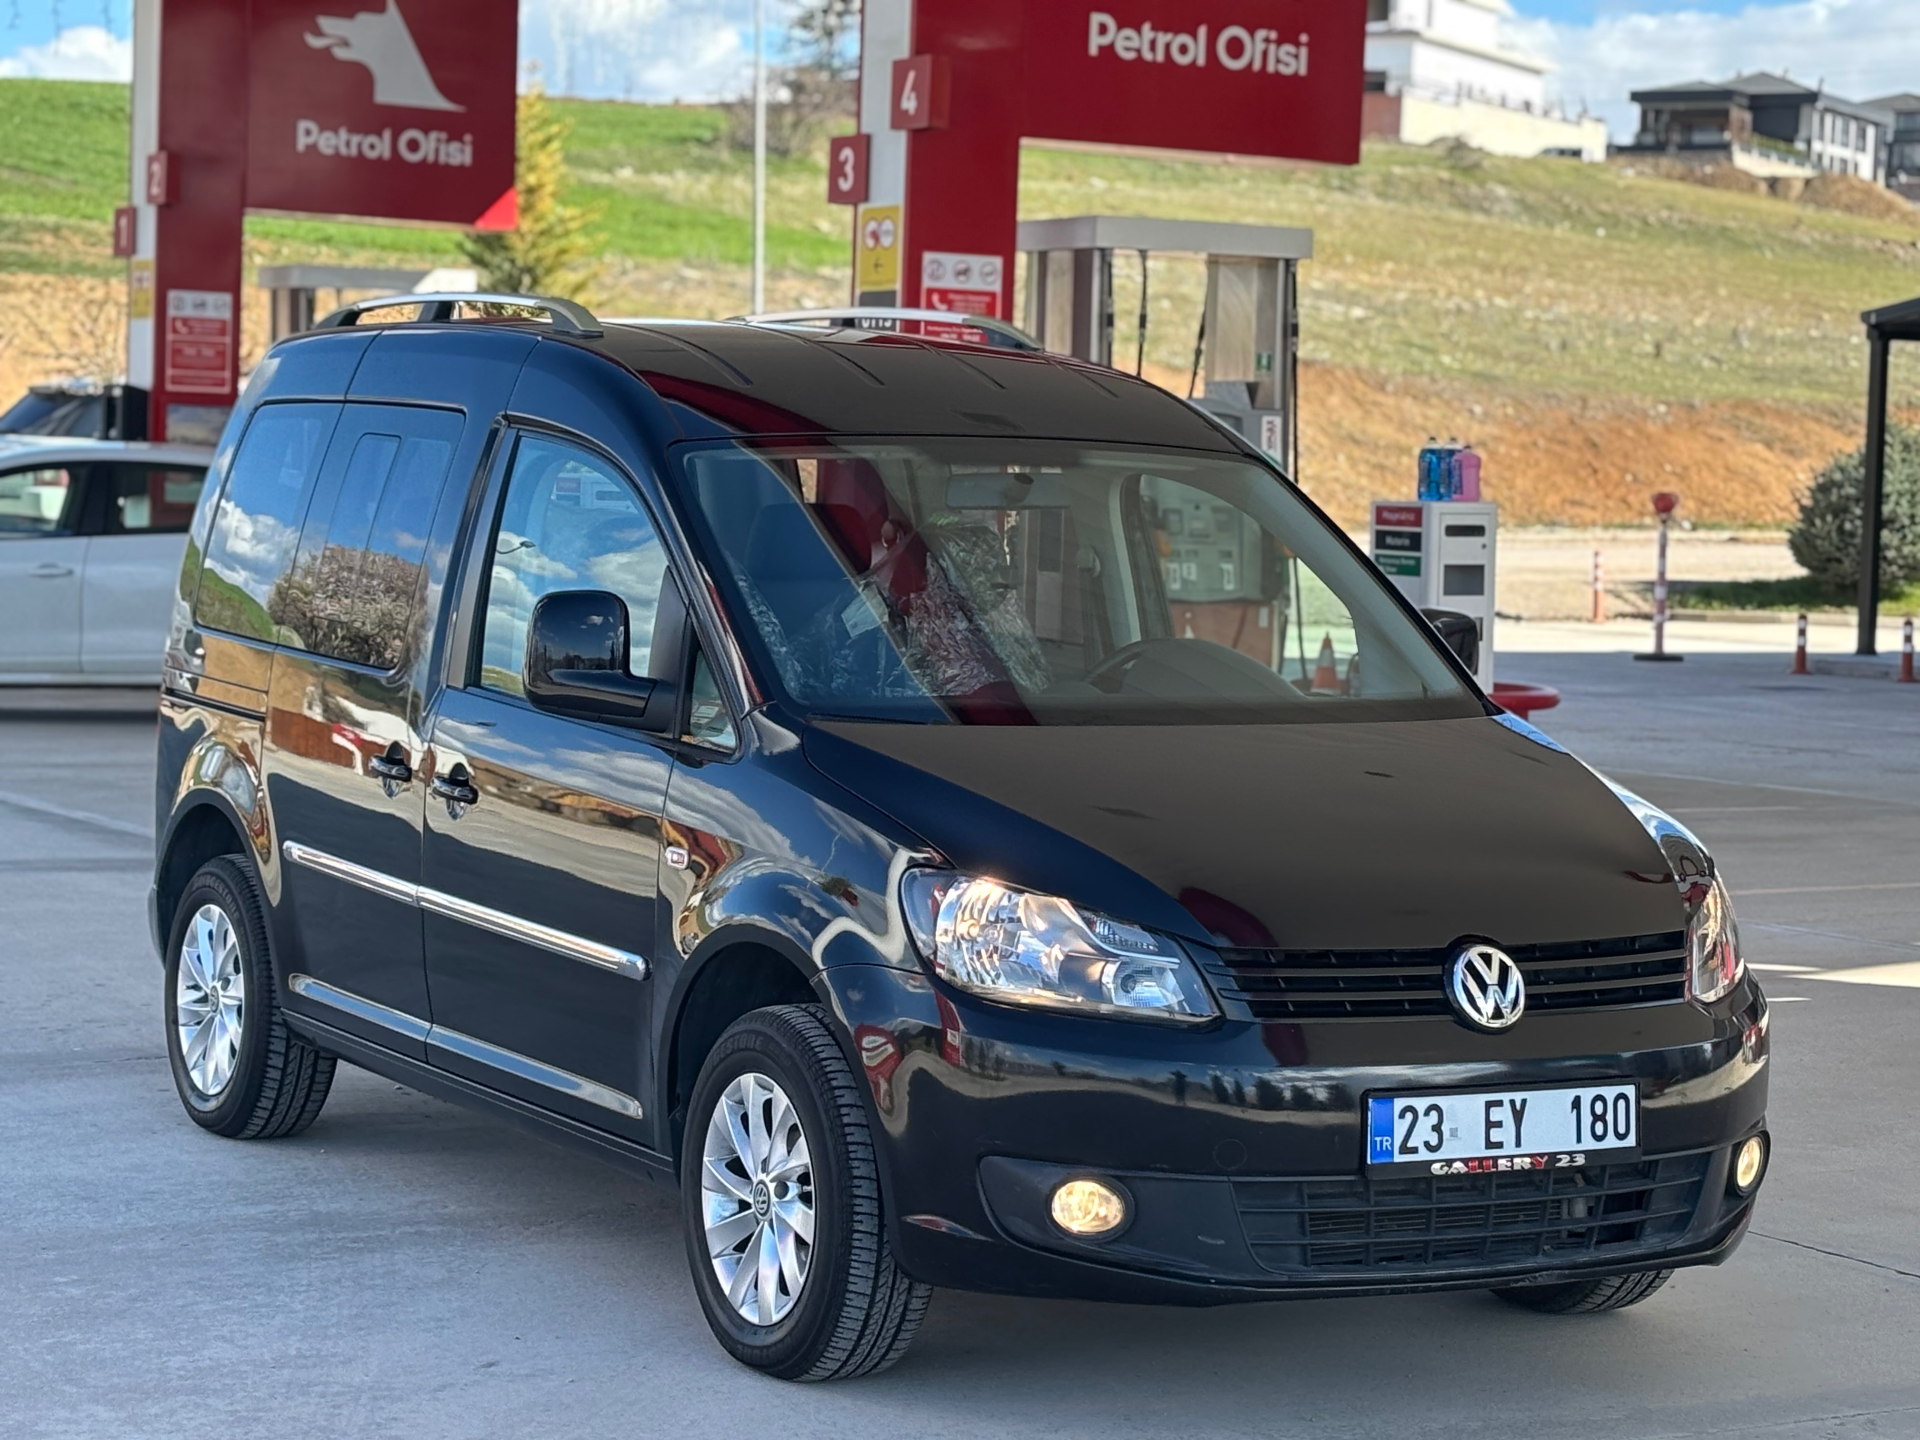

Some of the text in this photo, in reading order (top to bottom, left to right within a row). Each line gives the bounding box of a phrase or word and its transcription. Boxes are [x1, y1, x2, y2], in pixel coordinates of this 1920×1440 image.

[1088, 11, 1309, 77] Petrol Ofisi
[900, 69, 918, 116] 4
[296, 118, 473, 167] Petrol Ofisi
[149, 161, 161, 196] 2
[837, 146, 855, 192] 3
[118, 215, 129, 249] 1
[1374, 1136, 1392, 1152] TR
[1398, 1091, 1631, 1155] 23 EY 180
[1430, 1153, 1586, 1175] GALLERY 23
